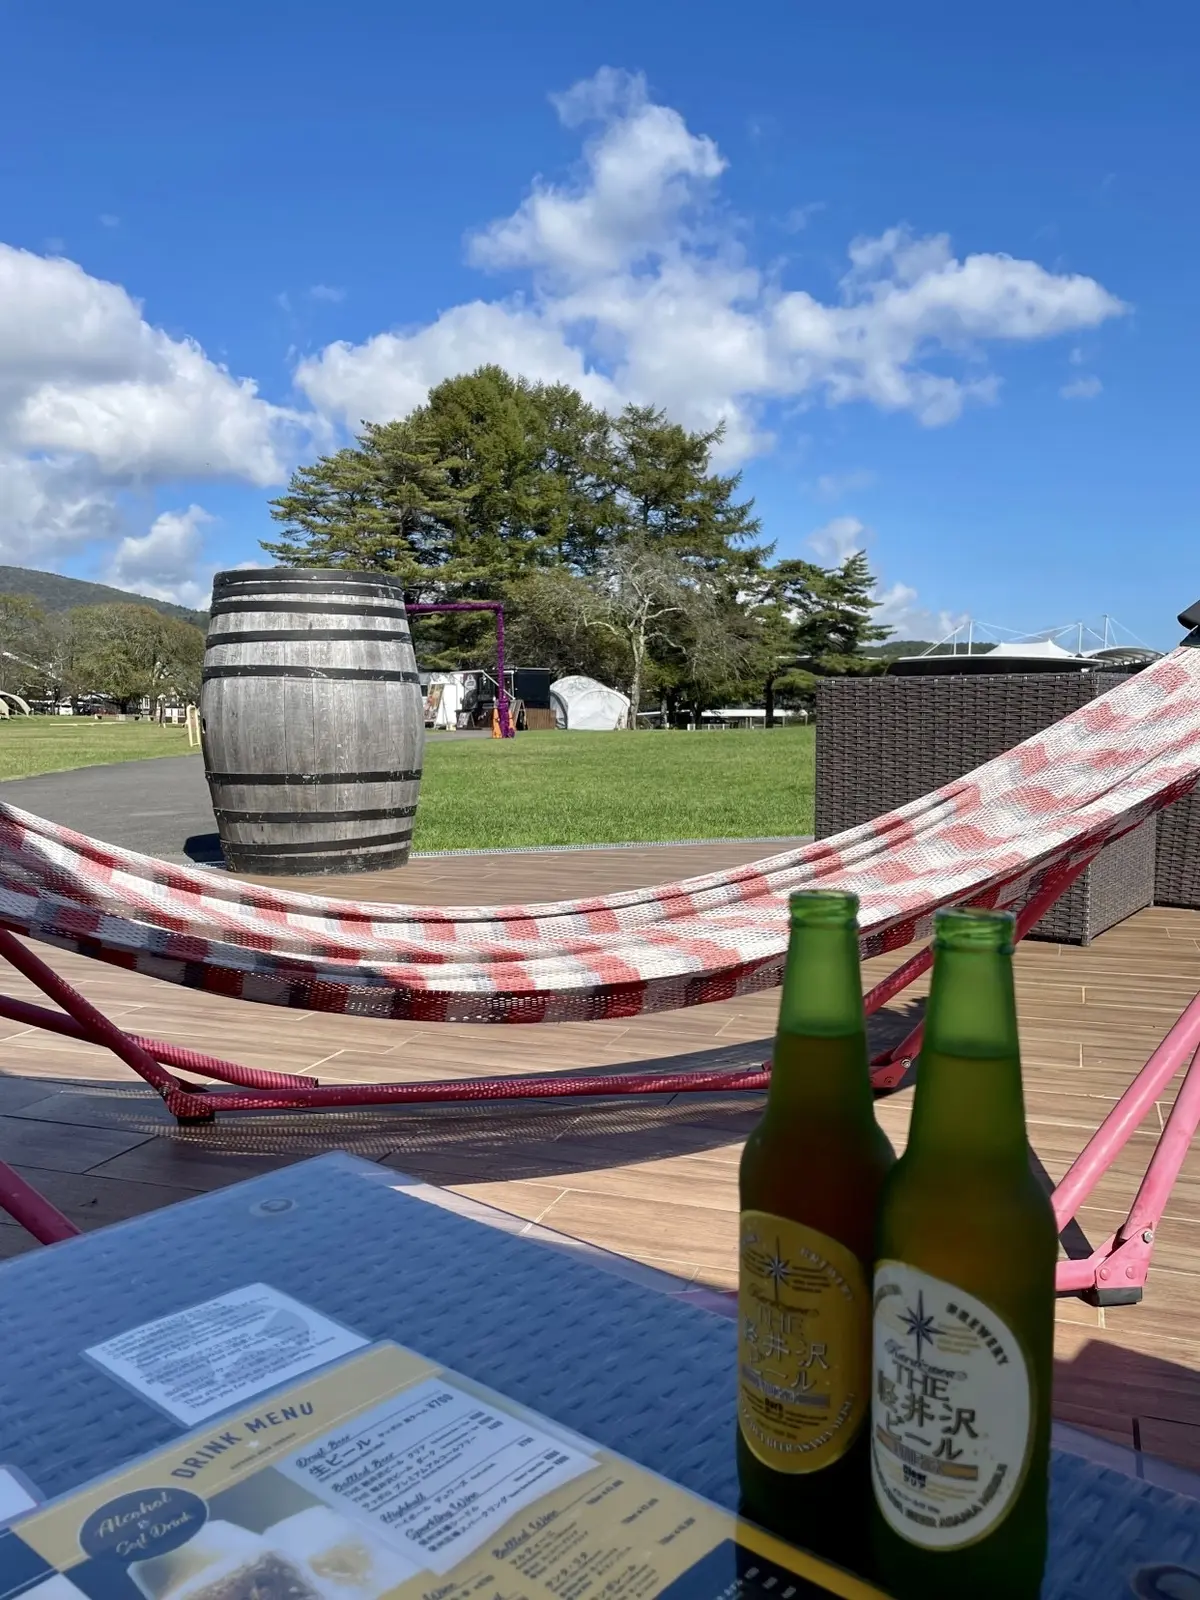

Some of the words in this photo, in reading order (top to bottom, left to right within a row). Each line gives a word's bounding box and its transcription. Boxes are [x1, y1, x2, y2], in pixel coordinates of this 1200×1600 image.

[946, 1302, 1009, 1366] BREWERY
[891, 1358, 950, 1402] THE
[170, 1431, 243, 1481] DRINK
[244, 1401, 315, 1434] MENU
[309, 1439, 371, 1478] 生ビール
[886, 1410, 963, 1460] ビール
[94, 1491, 172, 1538] Alcohol
[149, 1511, 195, 1538] Drink
